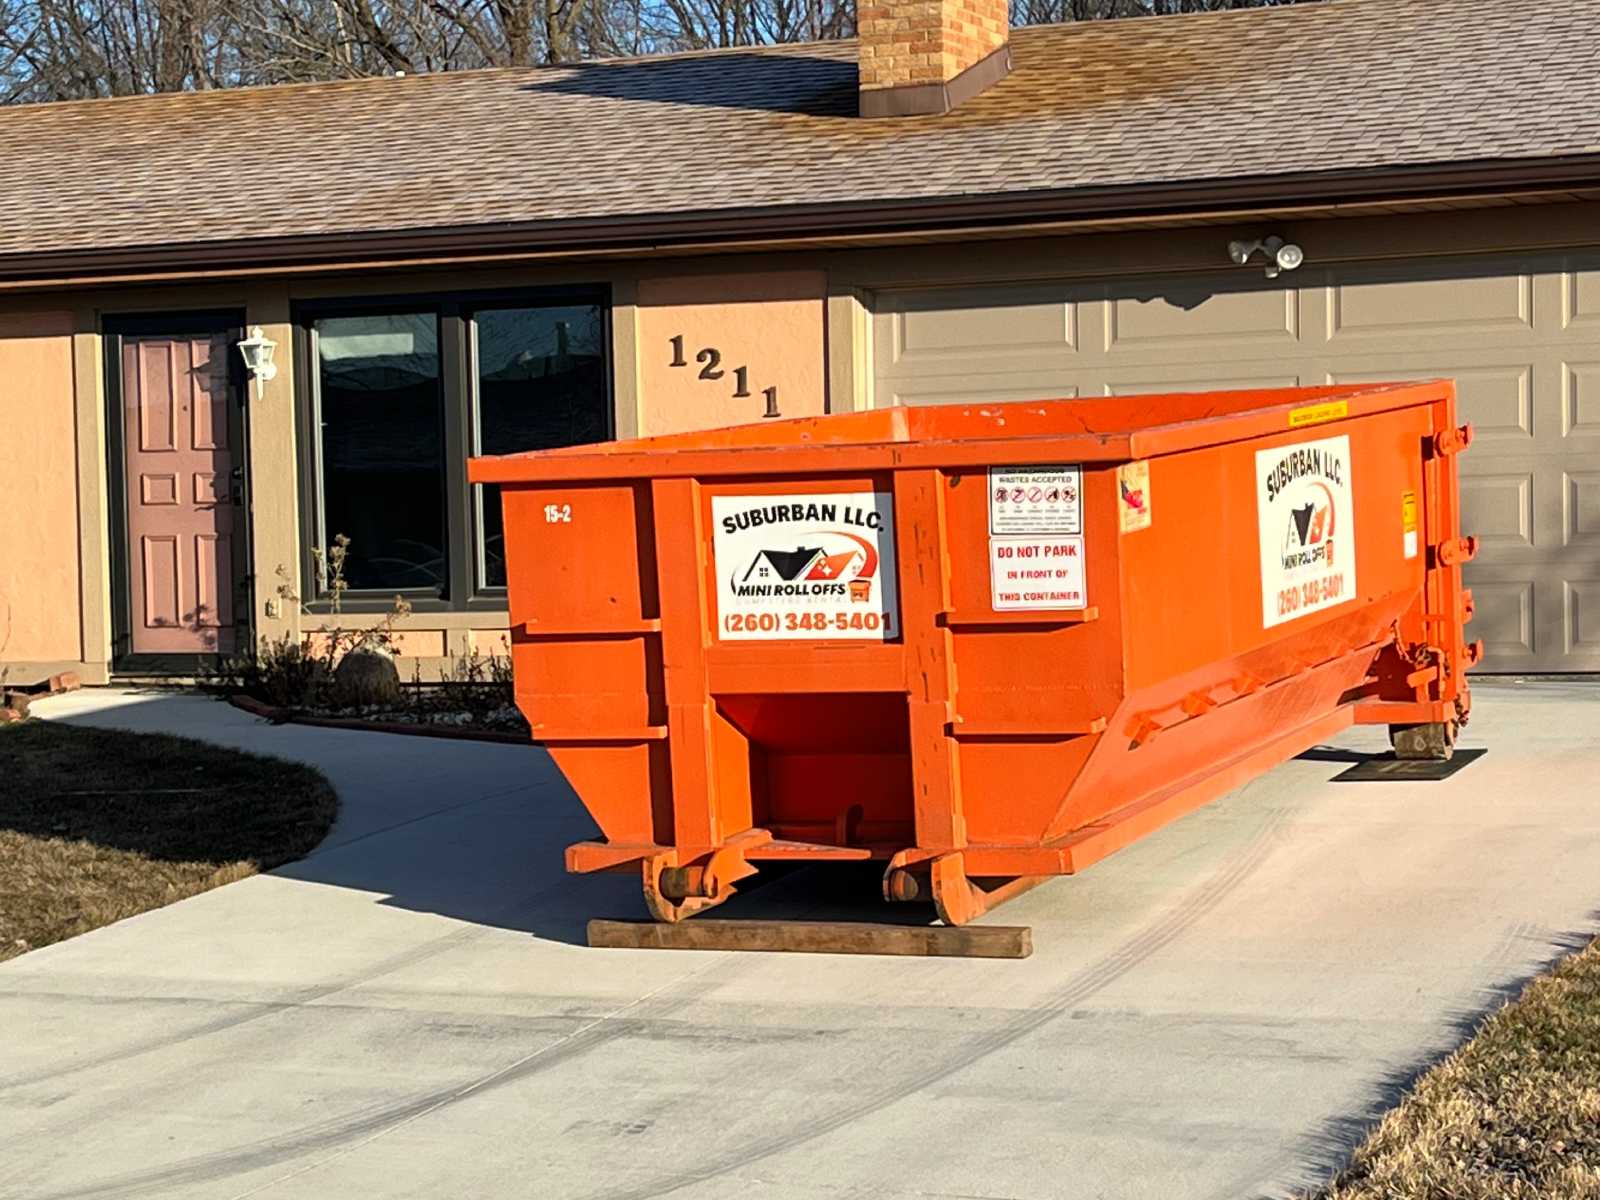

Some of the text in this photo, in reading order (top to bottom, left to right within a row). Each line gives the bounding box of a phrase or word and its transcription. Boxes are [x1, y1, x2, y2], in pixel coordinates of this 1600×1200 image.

[668, 334, 781, 418] 1211
[999, 475, 1072, 484] WASTES ACCEPTED
[1267, 448, 1320, 502] SUBURBAN
[544, 504, 571, 523] 15-2
[722, 503, 884, 534] SUBURBAN LLC.
[997, 544, 1077, 558] DO NOT PARK
[1007, 569, 1068, 579] IN FRONT OF
[737, 583, 846, 597] MINI ROLL OFFS
[999, 591, 1079, 601] THIS CONTAINER
[724, 611, 891, 632] (260) 348-5401
